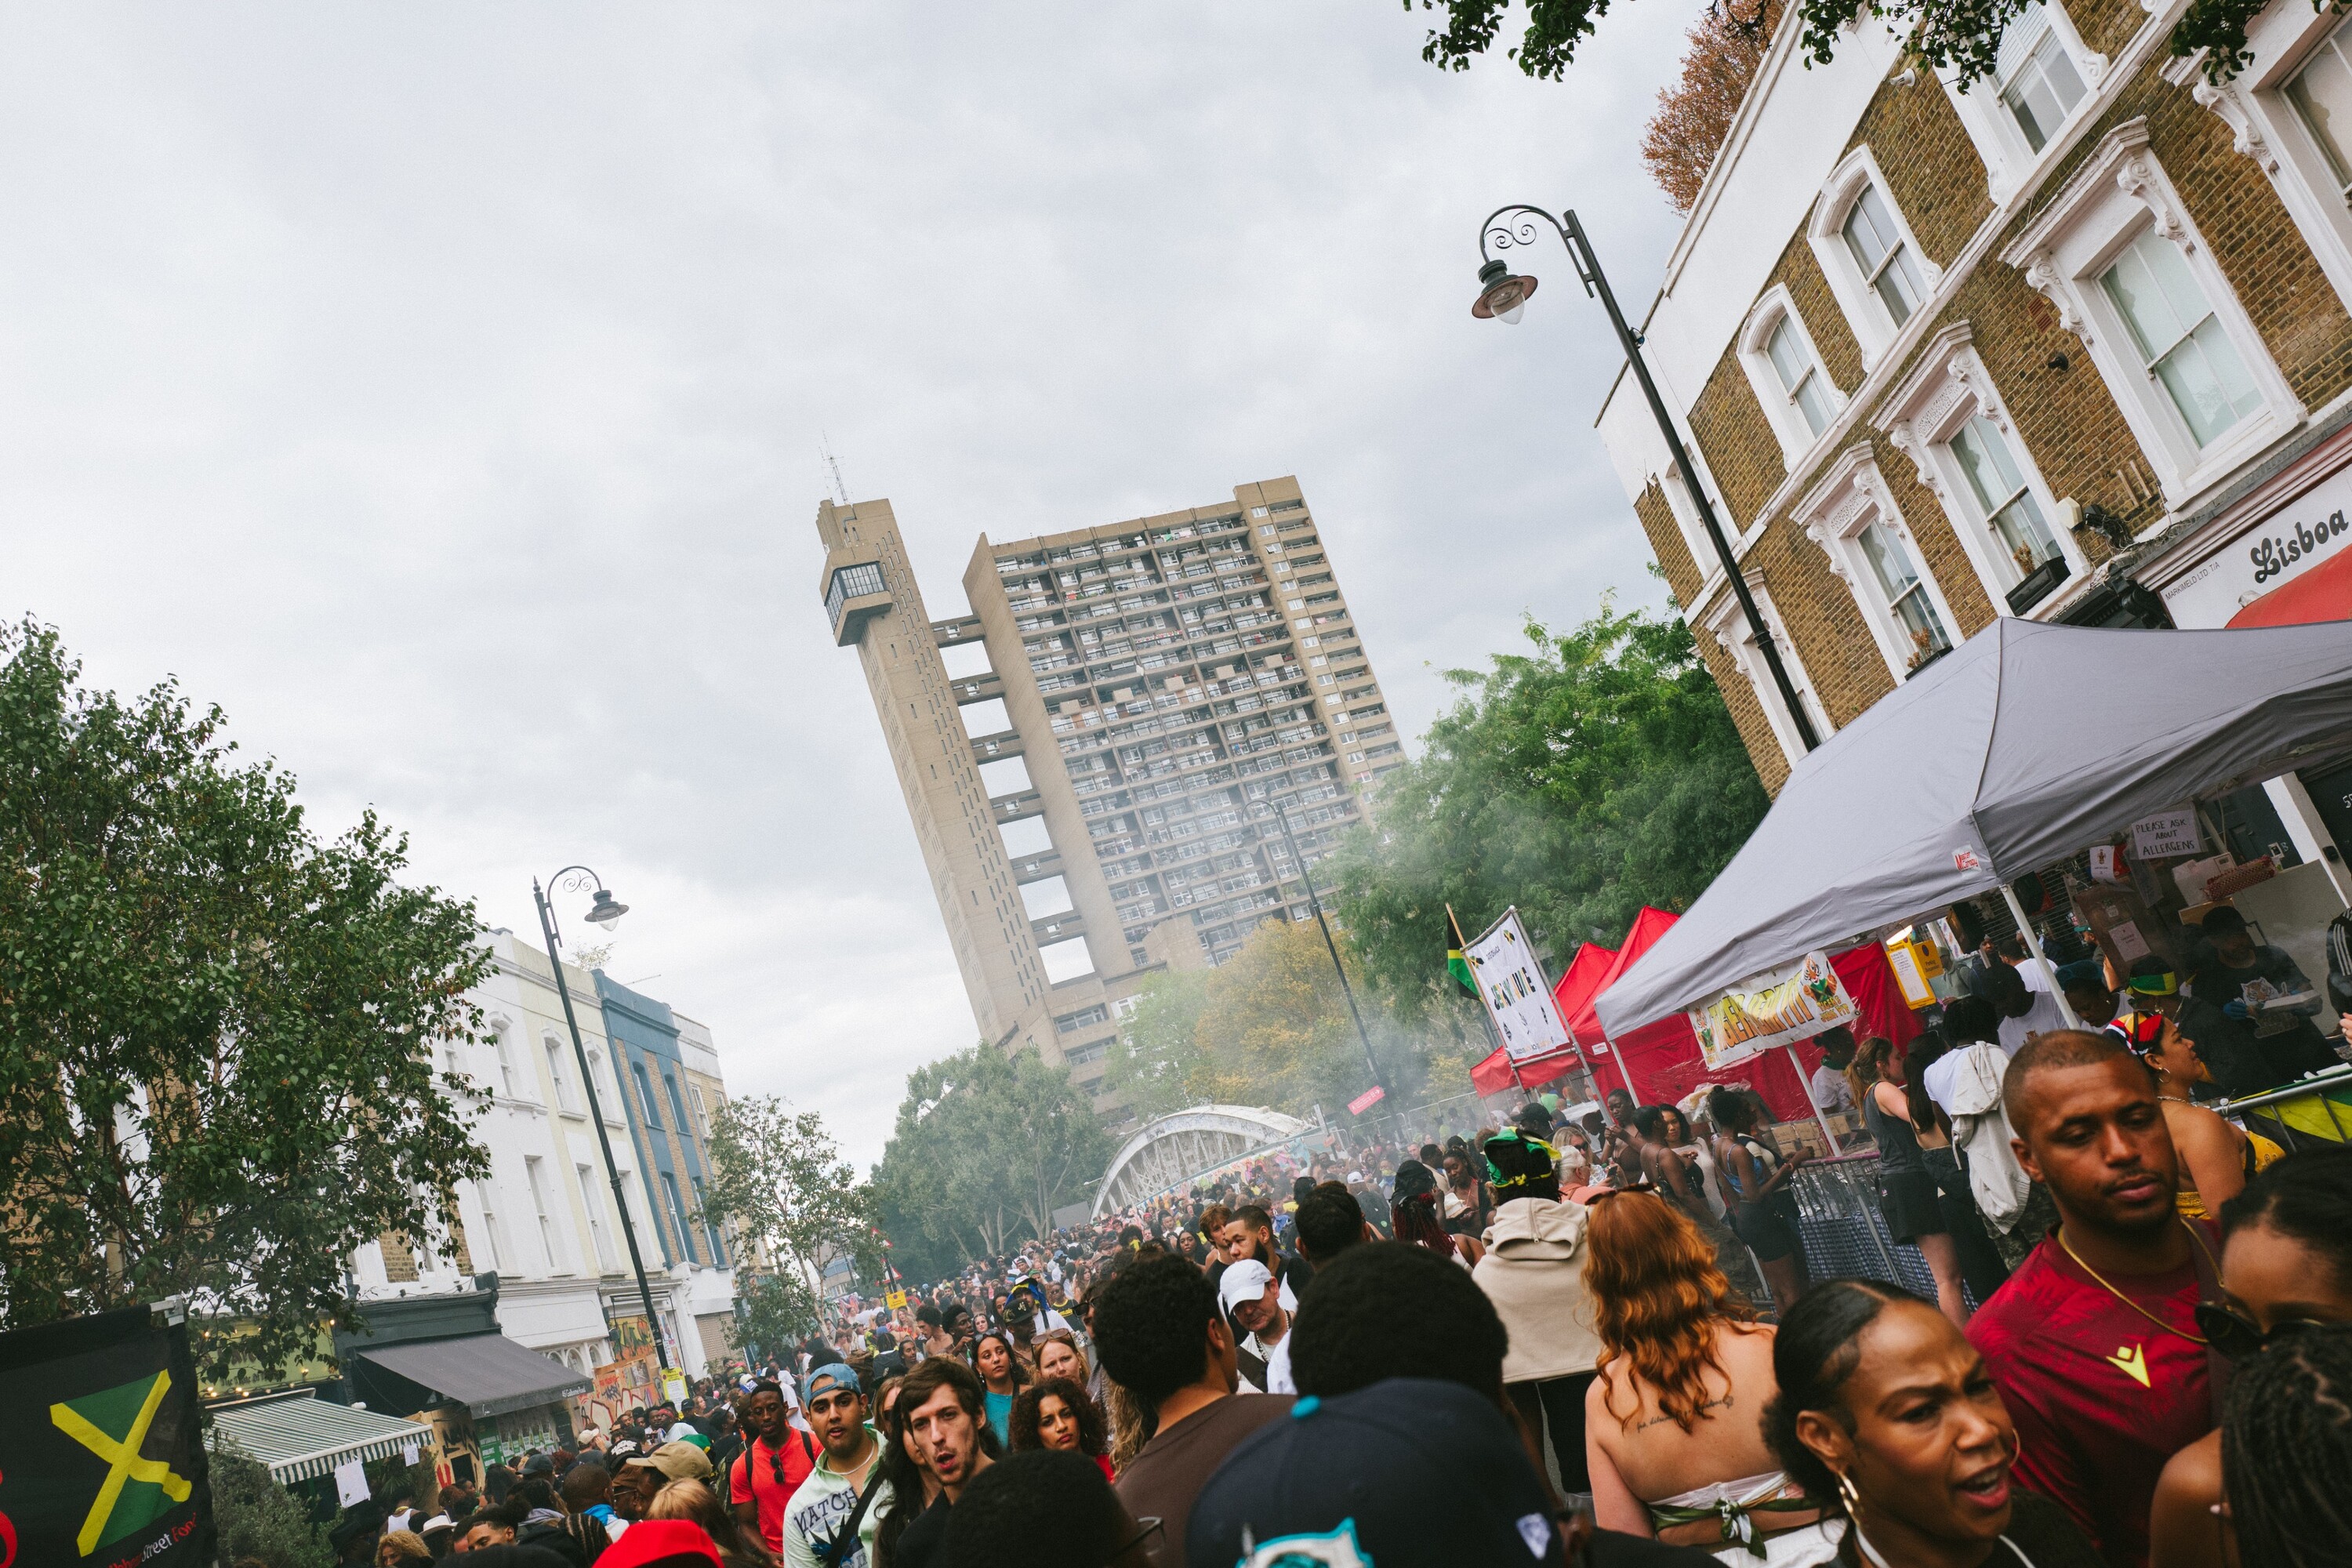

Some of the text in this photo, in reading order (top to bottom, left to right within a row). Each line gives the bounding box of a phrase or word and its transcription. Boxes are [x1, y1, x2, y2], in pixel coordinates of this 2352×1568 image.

[2250, 509, 2349, 583] Lisboa
[2197, 568, 2209, 580] LTD
[2209, 561, 2220, 572] T/A
[2136, 818, 2187, 833] PLEASE ASK
[2155, 829, 2178, 840] ABOUT
[2143, 840, 2195, 856] ALLERGENS
[1708, 993, 1759, 1052] TIGER
